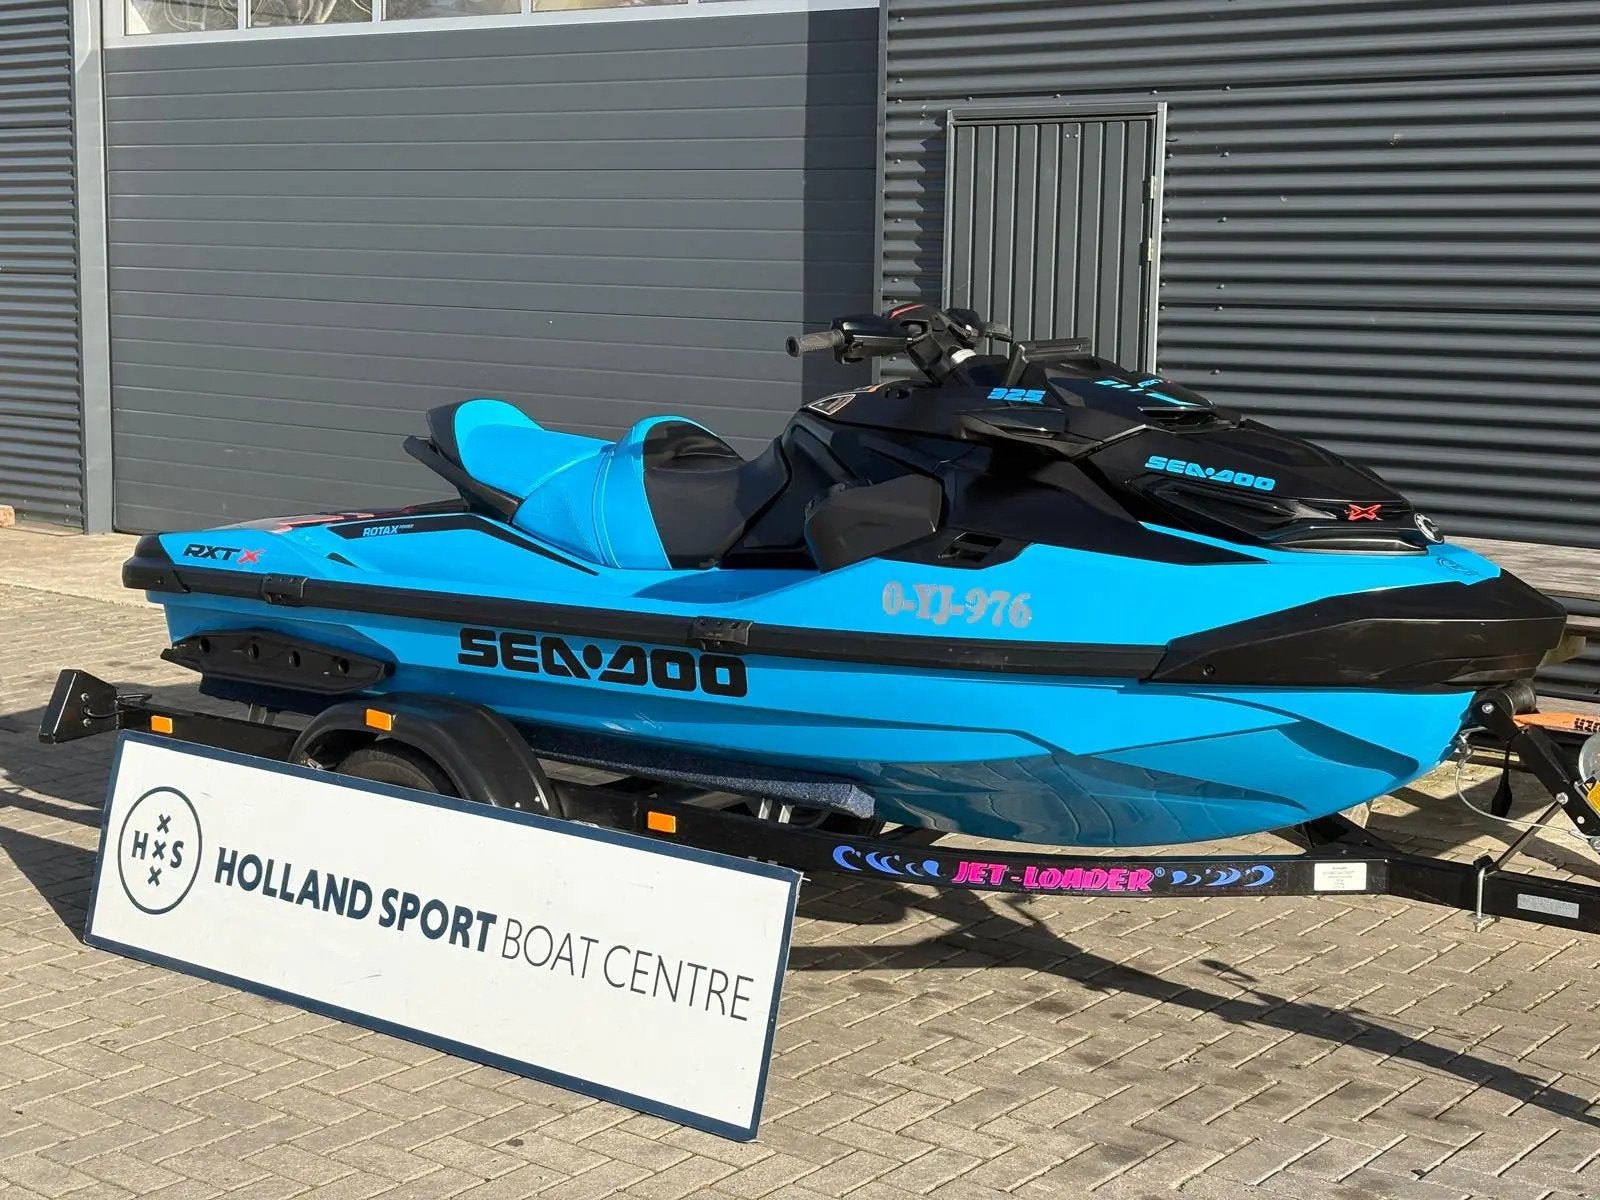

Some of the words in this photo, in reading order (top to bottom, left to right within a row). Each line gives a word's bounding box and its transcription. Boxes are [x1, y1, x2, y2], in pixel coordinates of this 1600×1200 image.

[987, 387, 1046, 404] 325
[363, 525, 399, 537] ROTAX
[183, 543, 242, 561] RXT
[214, 846, 374, 920] HOLLAND
[378, 887, 498, 953] SPORT
[501, 917, 600, 979] BOAT
[603, 944, 755, 1022] CENTRE
